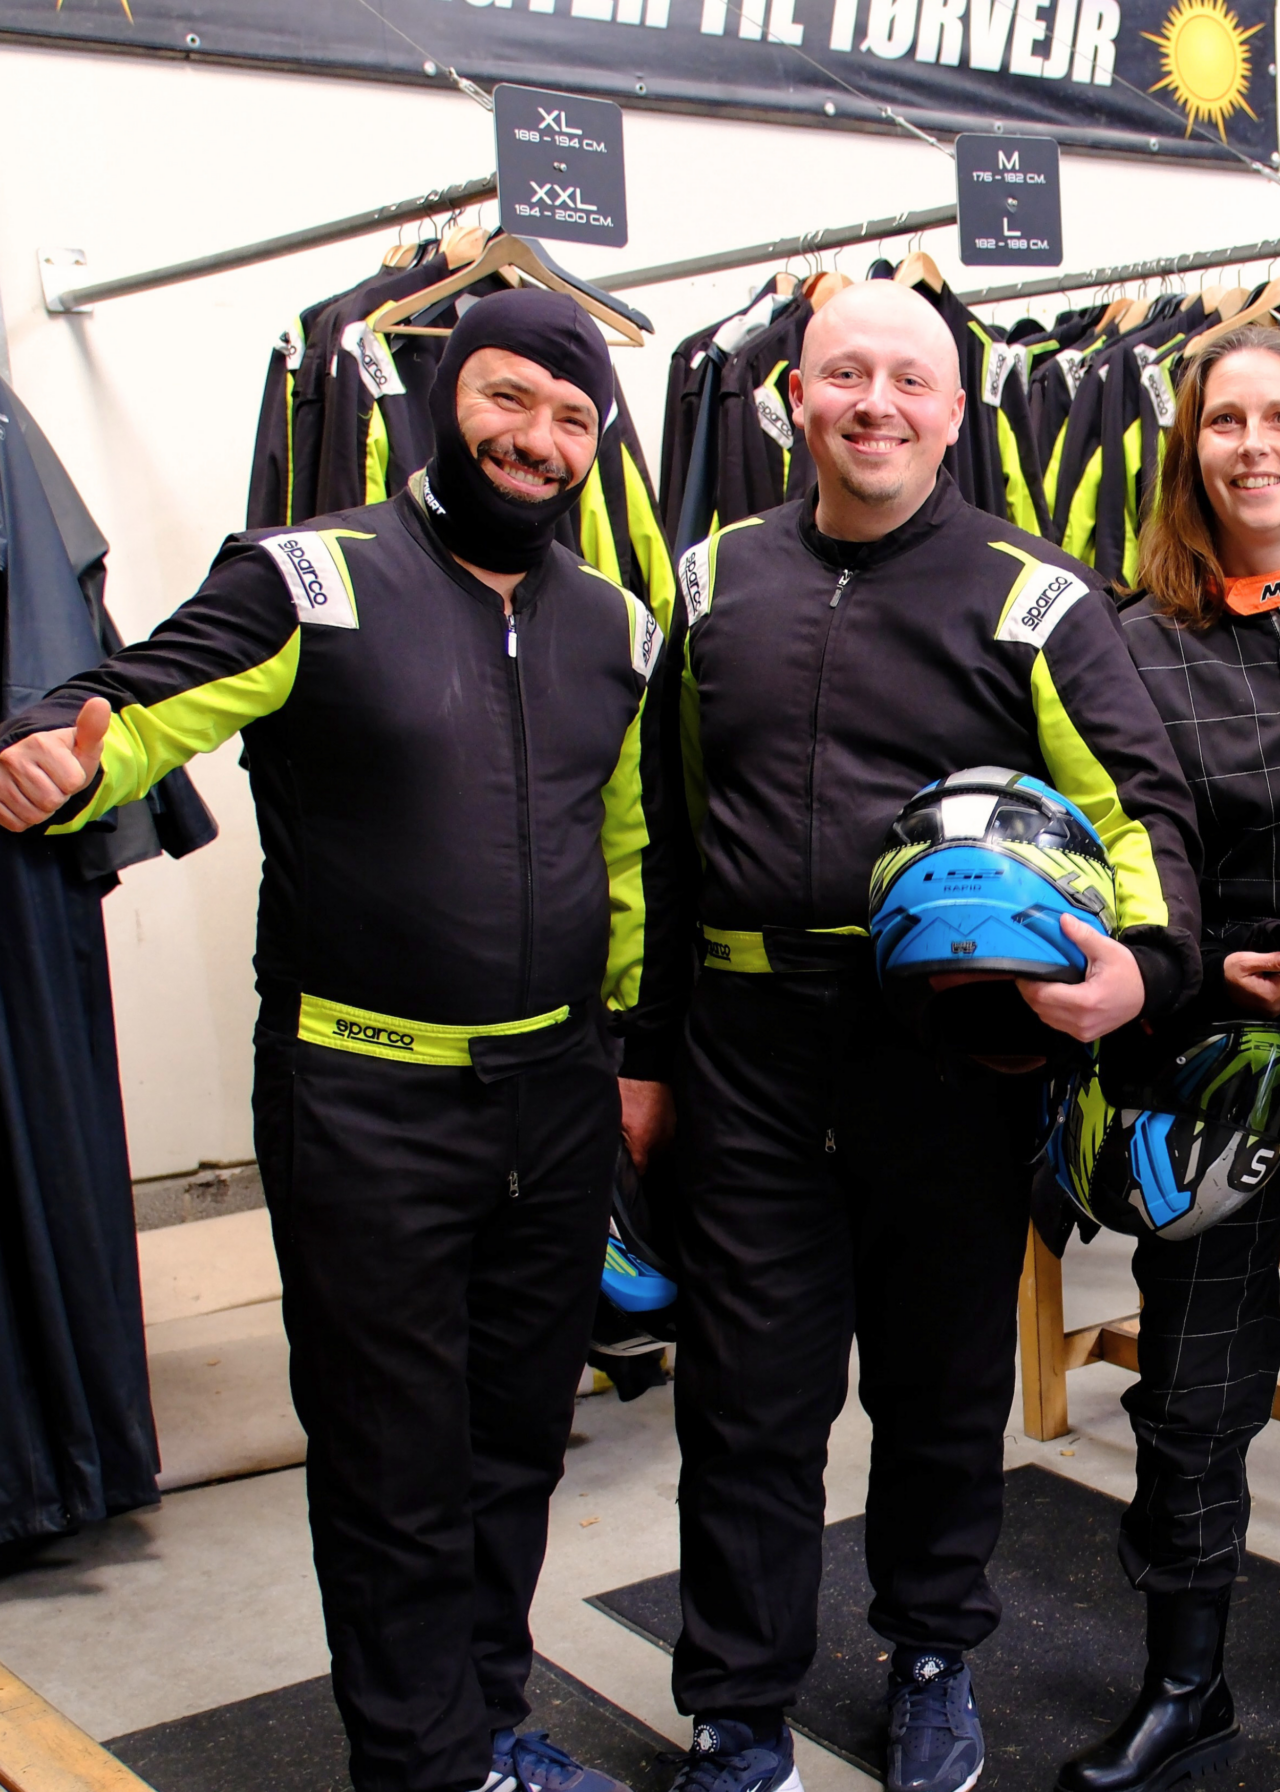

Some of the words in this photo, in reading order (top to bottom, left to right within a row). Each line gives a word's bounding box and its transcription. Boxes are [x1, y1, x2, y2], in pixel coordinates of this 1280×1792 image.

[537, 107, 583, 135] XL
[514, 128, 540, 143] 188
[554, 135, 580, 149] 194
[583, 139, 608, 153] CM.
[998, 149, 1020, 171] M
[972, 171, 993, 182] 176
[1003, 172, 1025, 183] 182
[529, 180, 598, 211] XXL
[514, 203, 541, 218] 194
[555, 209, 587, 224] 200
[589, 213, 614, 227] CM.
[1003, 217, 1022, 237] L
[974, 238, 996, 249] 182
[1007, 238, 1028, 250] 188
[278, 539, 328, 608] sparco
[1021, 576, 1073, 632] sparco
[943, 883, 982, 893] RAPID
[332, 1018, 415, 1051] sparco
[1239, 1148, 1275, 1185] S
